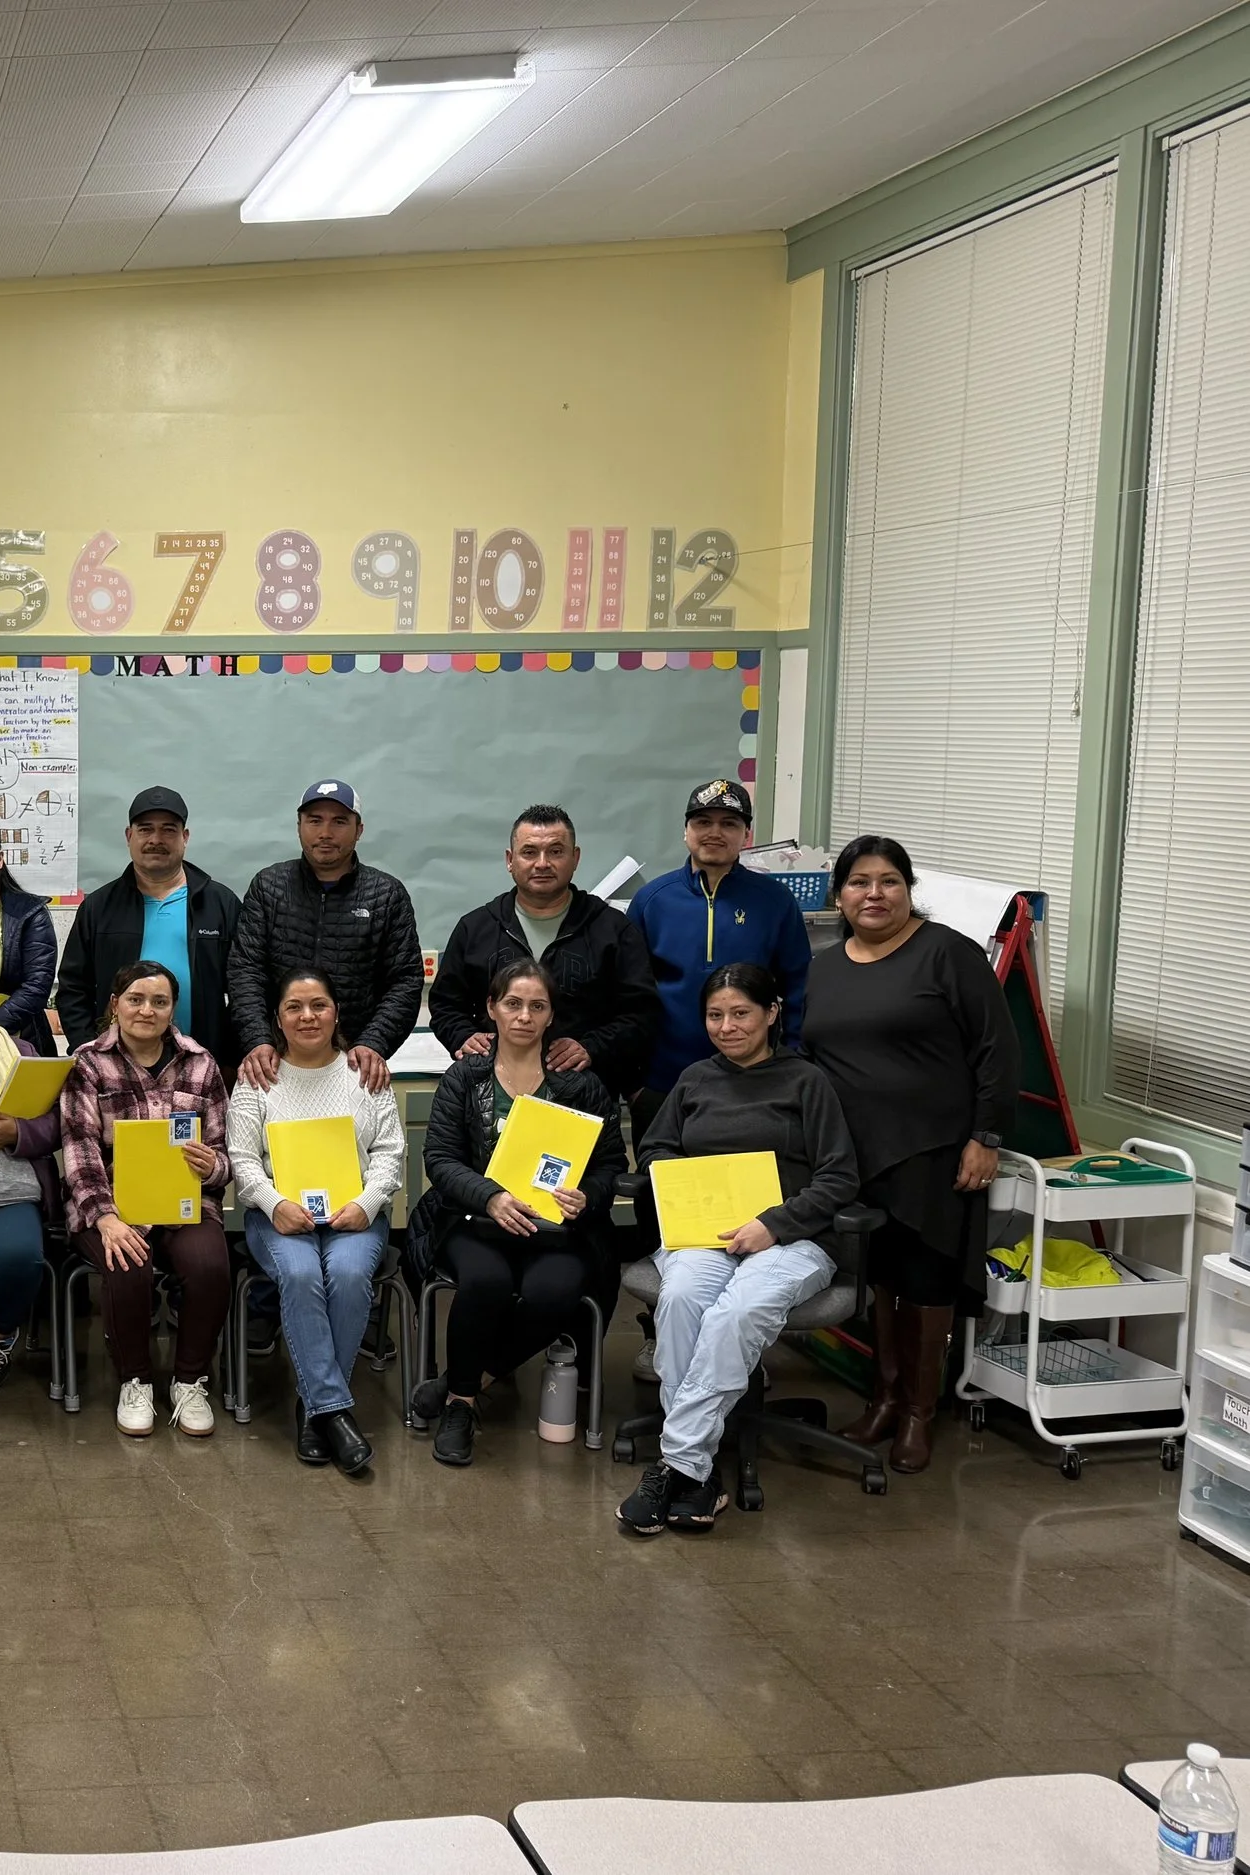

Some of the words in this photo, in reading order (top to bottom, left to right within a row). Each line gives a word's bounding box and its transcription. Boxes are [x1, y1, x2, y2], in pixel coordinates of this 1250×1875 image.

[162, 541, 167, 549] 7
[172, 539, 180, 548] 14
[185, 539, 193, 548] 21
[196, 539, 207, 548] 28
[209, 539, 220, 547] 35
[282, 537, 293, 546] 24
[379, 537, 389, 546] 27
[460, 536, 469, 544] 10
[511, 537, 522, 546] 60
[659, 537, 666, 545] 12
[265, 546, 274, 554] 16
[300, 545, 310, 553] 32
[364, 544, 375, 552] 36
[204, 551, 215, 560] 42
[484, 550, 497, 559] 120
[684, 550, 694, 558] 72
[357, 558, 368, 566] 45
[458, 556, 469, 564] 20
[657, 556, 667, 564] 24
[200, 562, 210, 571] 49
[302, 563, 313, 571] 40
[527, 561, 538, 569] 70
[195, 573, 205, 582] 56
[282, 575, 293, 584] 48
[361, 572, 371, 581] 54
[449, 527, 545, 632] 10
[457, 576, 468, 584] 30
[562, 527, 628, 632] 11
[646, 527, 739, 630] 12
[656, 575, 666, 583] 36
[67, 530, 135, 635] 6
[154, 531, 226, 635] 7
[255, 529, 321, 634] 8
[352, 530, 420, 633] 9
[373, 582, 384, 590] 63
[389, 580, 399, 589] 72
[479, 578, 490, 587] 110
[189, 585, 200, 593] 63
[264, 586, 275, 594] 56
[402, 586, 413, 594] 90
[525, 588, 536, 596] 80
[184, 596, 195, 605] 70
[455, 596, 466, 604] 40
[693, 592, 706, 600] 120
[303, 602, 314, 611] 88
[484, 607, 498, 615] 100
[179, 608, 189, 616] 77
[273, 616, 283, 624] 72
[292, 616, 303, 624] 80
[399, 617, 412, 626] 108
[454, 616, 465, 624] 50
[514, 613, 525, 621] 90
[684, 612, 697, 621] 132
[709, 614, 722, 622] 144
[174, 618, 185, 627] 84
[115, 655, 240, 676] MATH
[22, 671, 29, 682] I
[24, 695, 55, 708] multiply
[61, 694, 74, 703] the
[29, 705, 42, 714] and
[31, 717, 39, 727] by
[1225, 1409, 1247, 1430] Math
